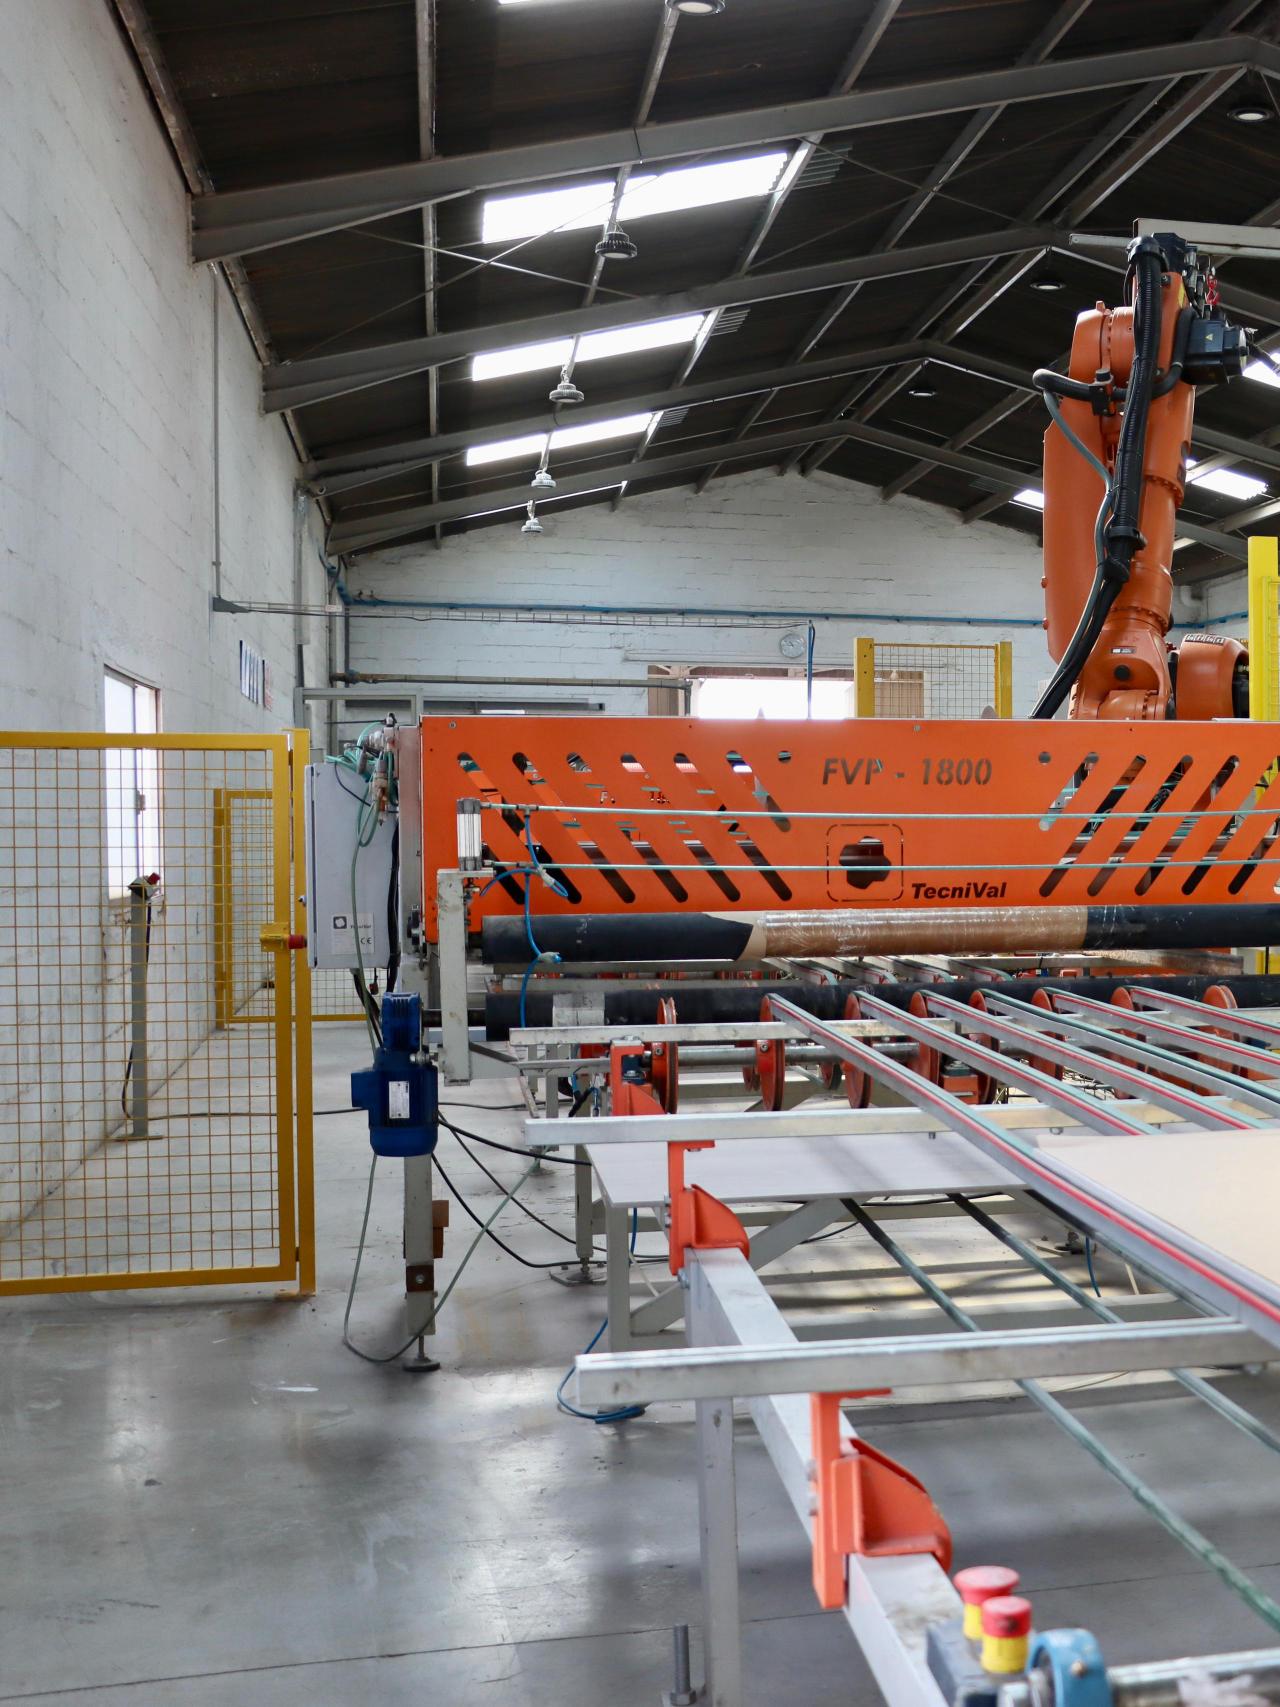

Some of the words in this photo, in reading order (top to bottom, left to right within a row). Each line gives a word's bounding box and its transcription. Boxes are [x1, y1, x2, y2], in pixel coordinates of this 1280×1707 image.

[822, 757, 884, 785] FVP
[922, 757, 992, 785] 1800
[911, 882, 1007, 899] TecniVal
